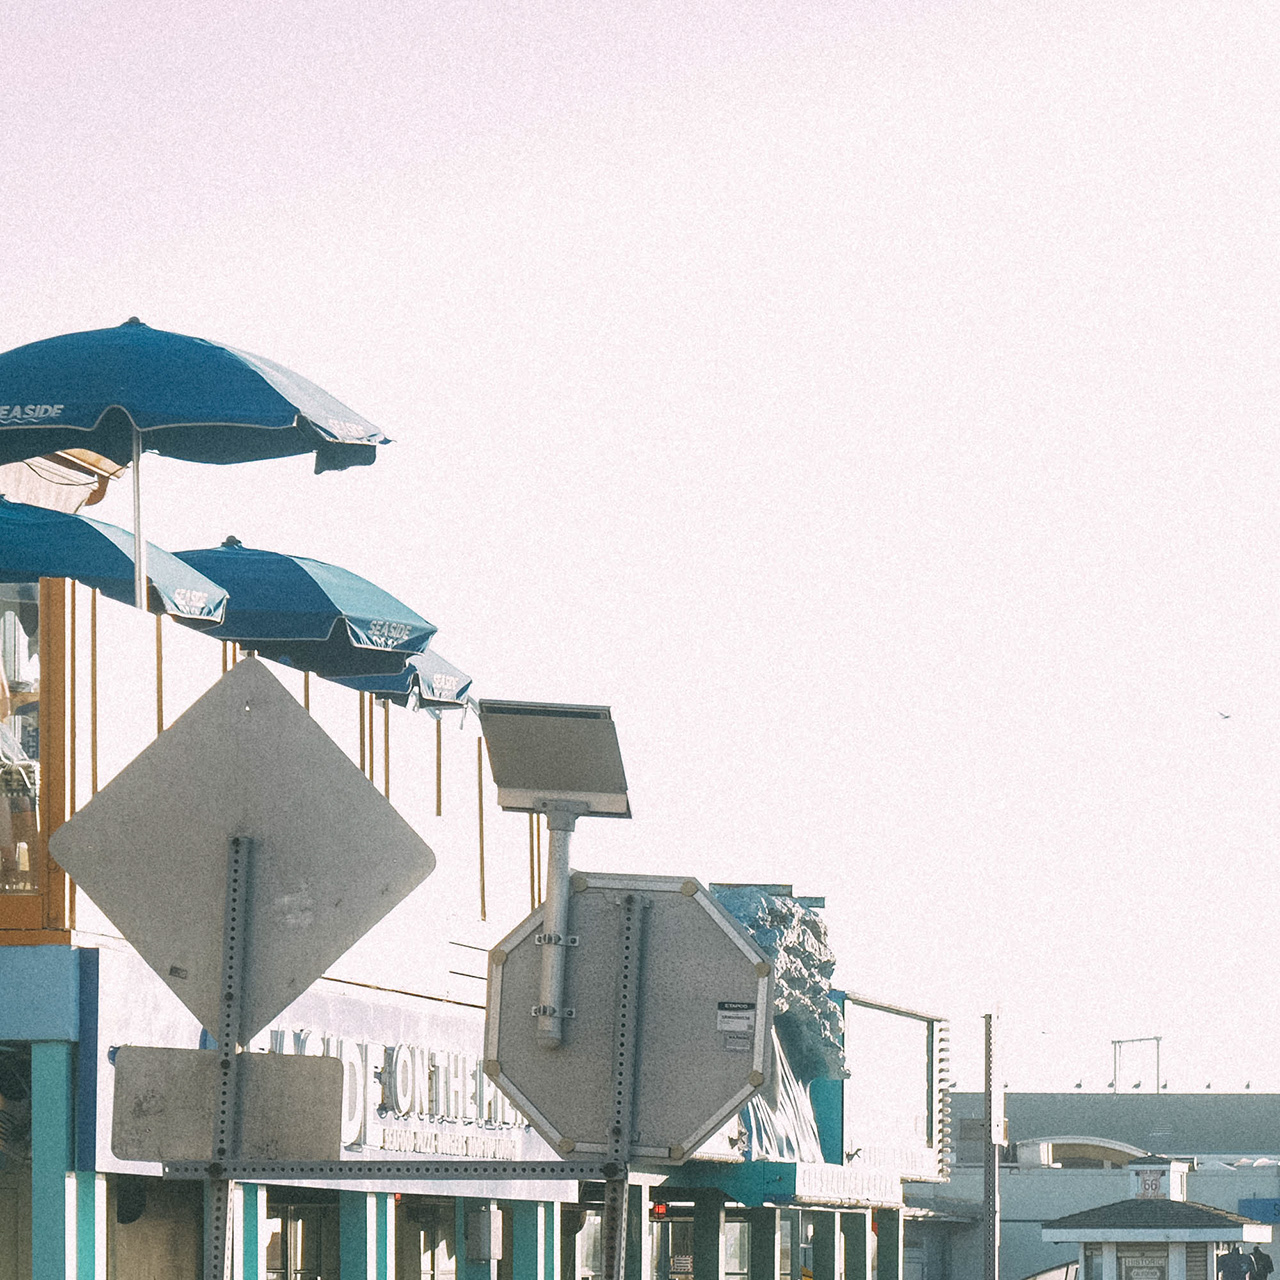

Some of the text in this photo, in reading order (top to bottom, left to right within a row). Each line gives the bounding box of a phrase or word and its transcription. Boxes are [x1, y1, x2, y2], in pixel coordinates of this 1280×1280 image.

[368, 620, 412, 640] SEASIDE
[1143, 1179, 1158, 1191] 66
[1126, 1258, 1164, 1267] HISTORIC
